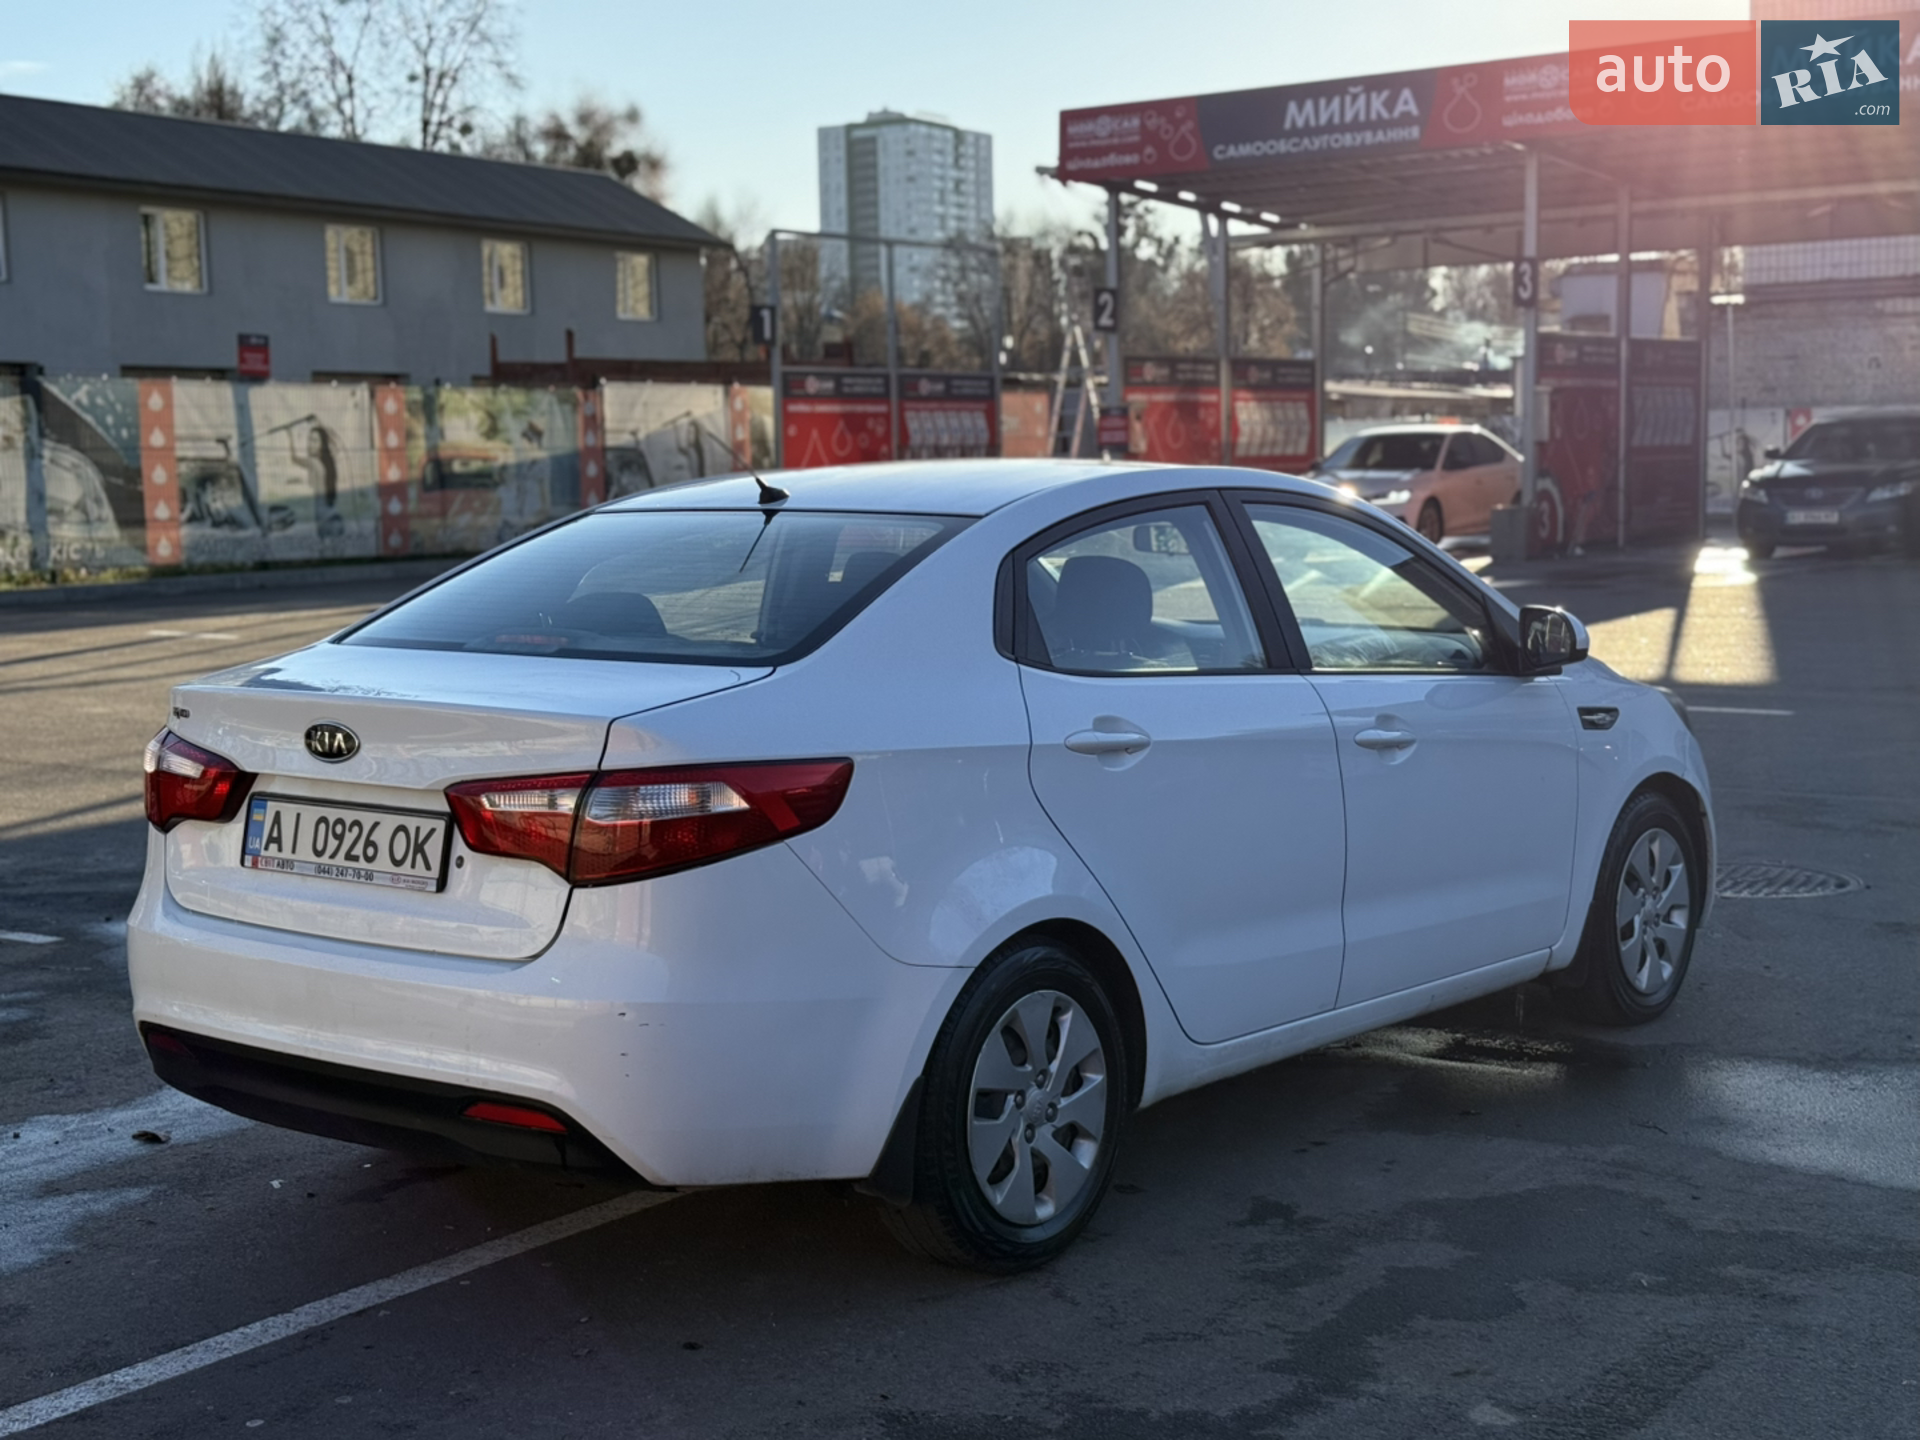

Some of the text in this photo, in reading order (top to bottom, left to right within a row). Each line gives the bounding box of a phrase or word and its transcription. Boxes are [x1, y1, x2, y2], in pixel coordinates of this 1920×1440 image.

[1283, 85, 1420, 131] МИЙКА
[1212, 125, 1421, 161] САМООБСЛУГОВУВАННЯ
[1518, 262, 1532, 300] 3
[760, 309, 771, 340] 1
[1098, 291, 1114, 327] 2
[310, 731, 348, 754] KIA
[249, 836, 261, 850] UA
[263, 810, 437, 872] AI 0926 OK
[314, 865, 334, 877] (044)
[335, 866, 374, 882] 247-70-00
